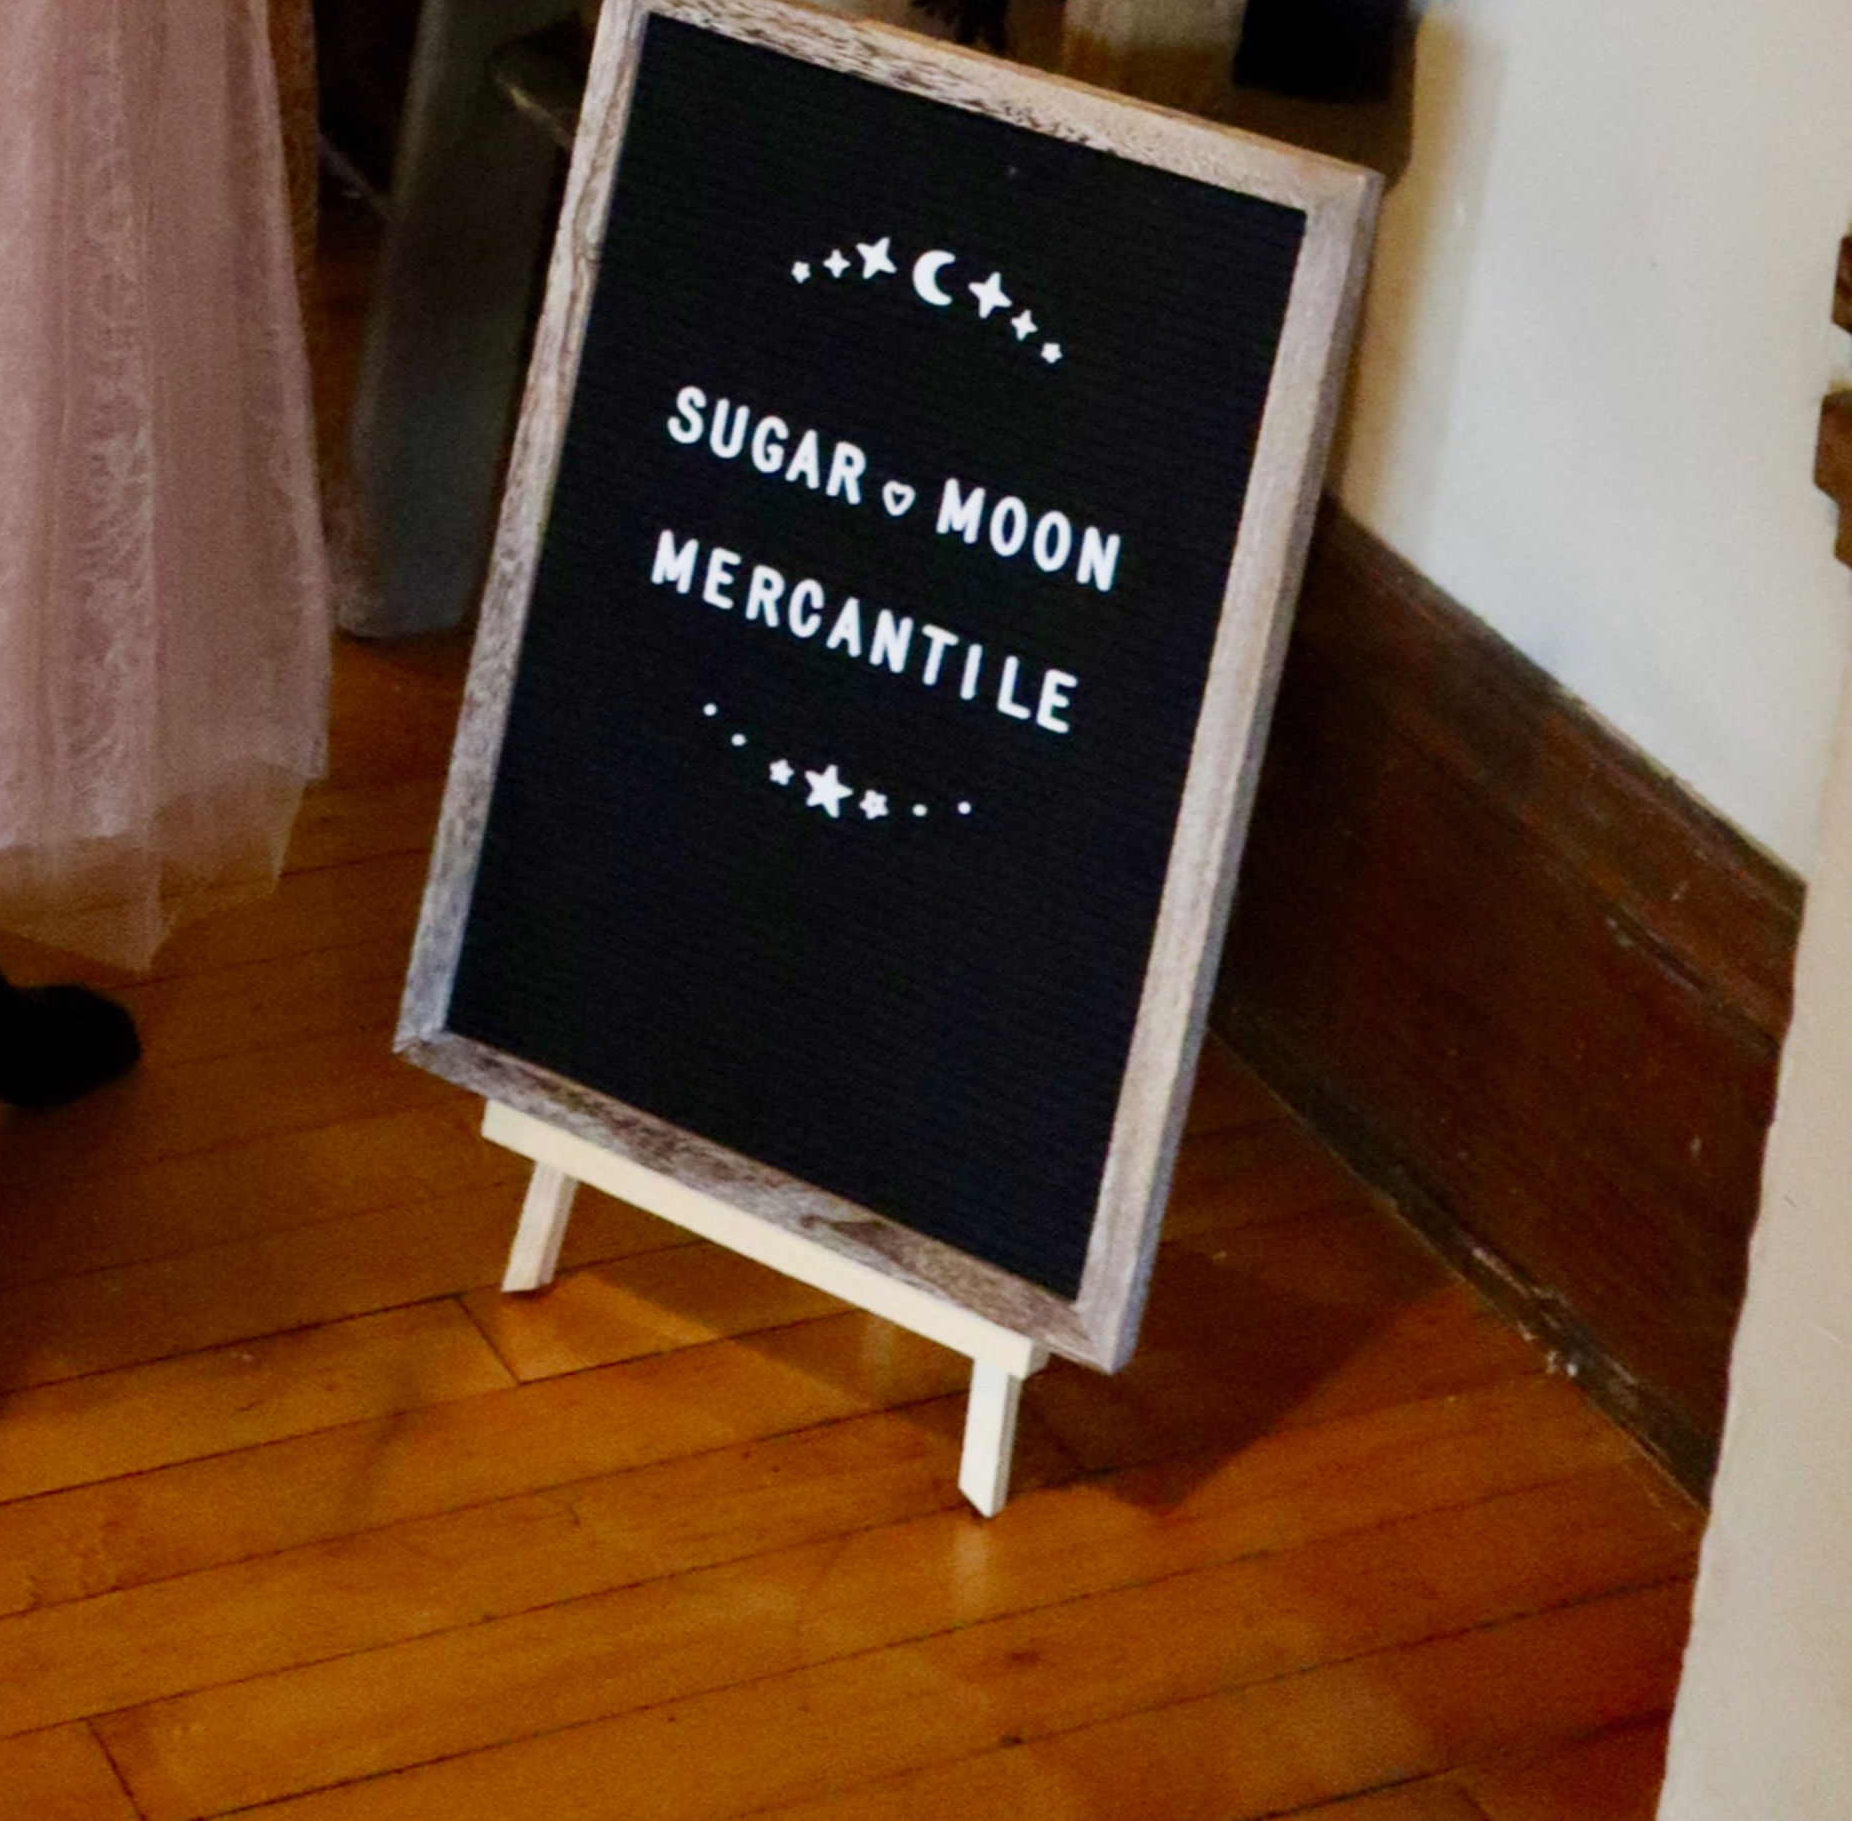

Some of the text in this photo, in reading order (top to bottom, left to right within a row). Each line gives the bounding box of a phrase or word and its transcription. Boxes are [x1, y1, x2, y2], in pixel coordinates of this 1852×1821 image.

[666, 385, 1122, 593] SUGAR MOON
[650, 528, 1079, 735] MERCANTILE
